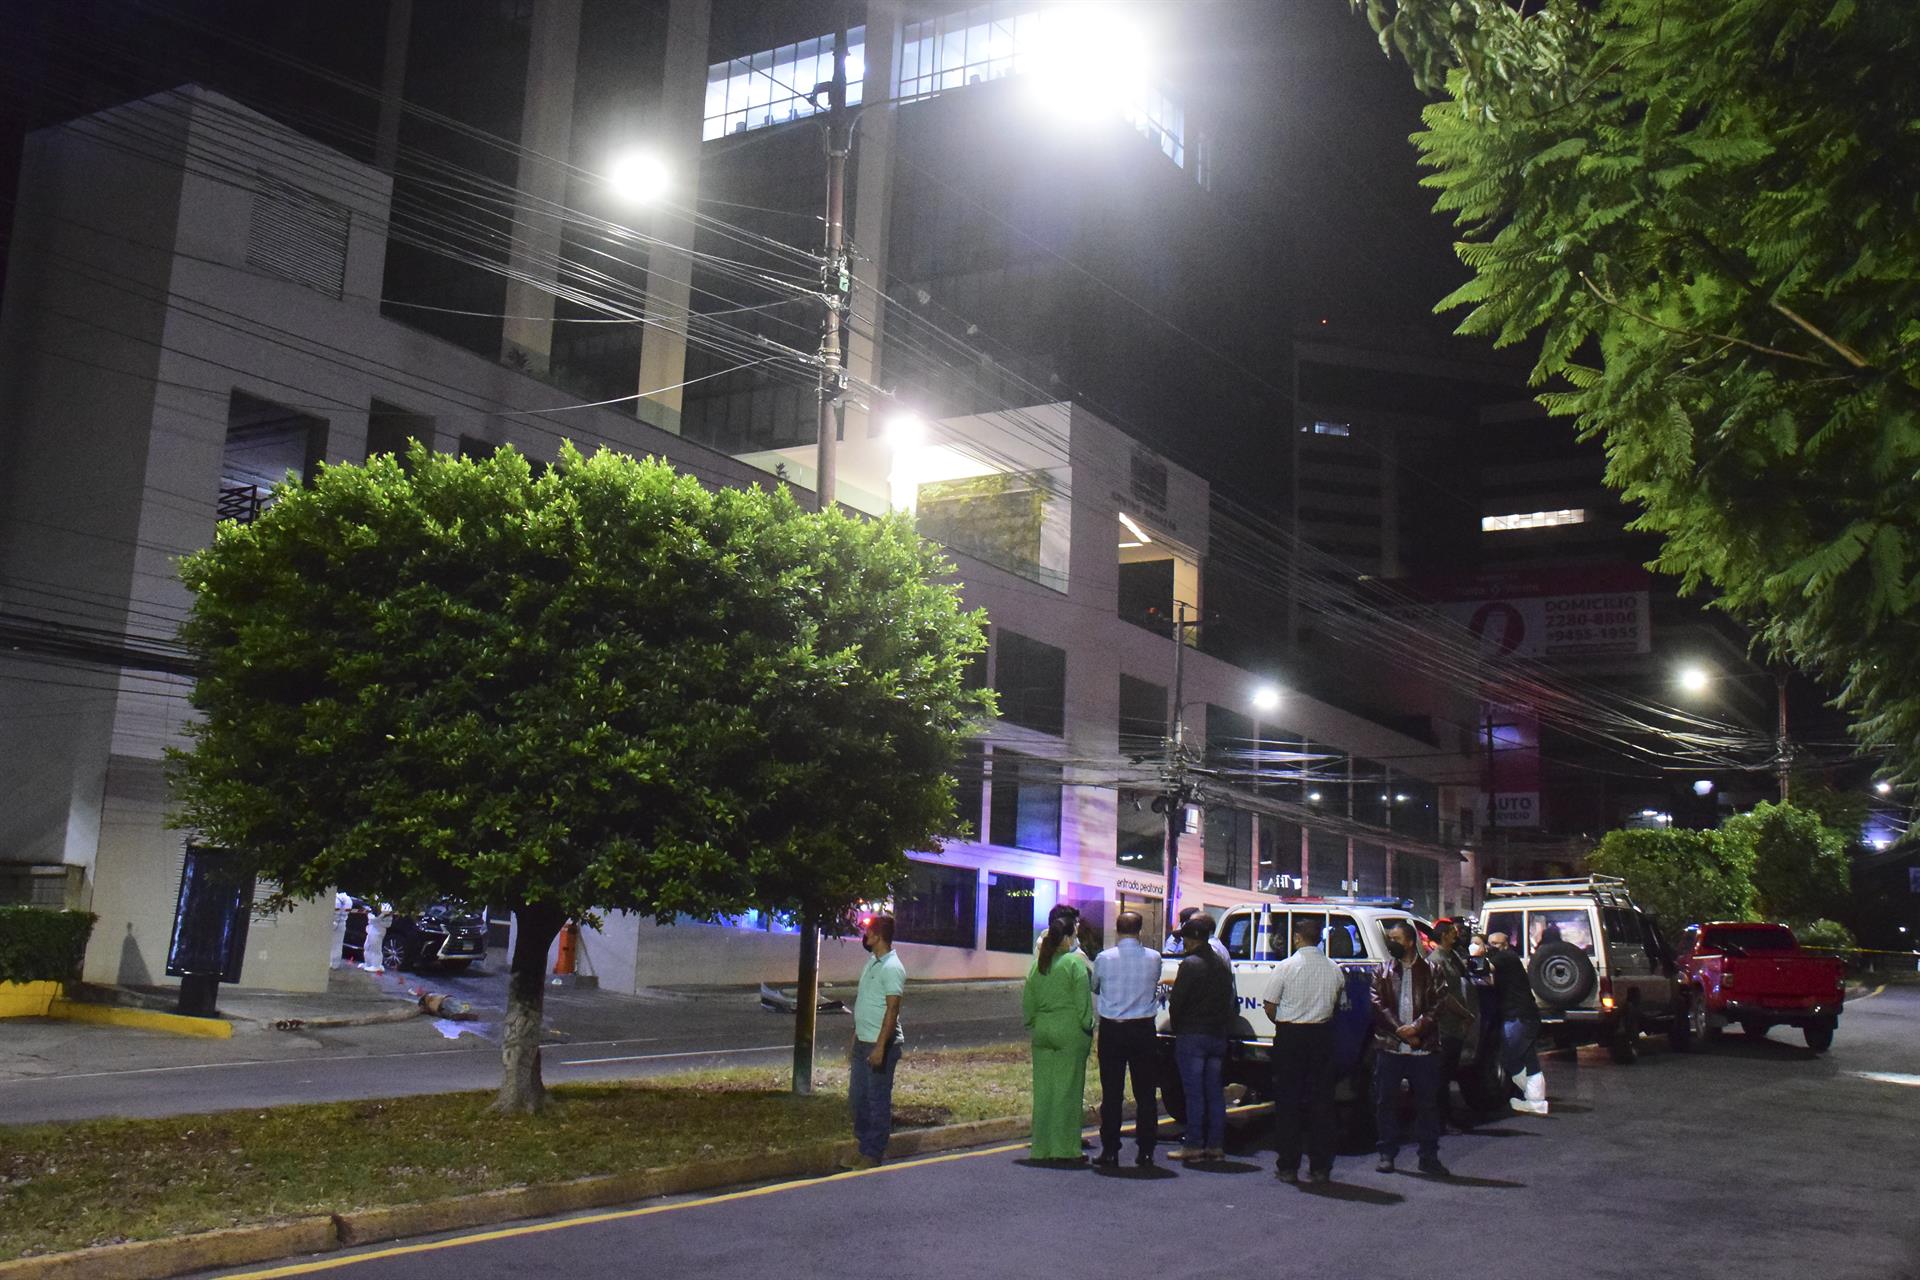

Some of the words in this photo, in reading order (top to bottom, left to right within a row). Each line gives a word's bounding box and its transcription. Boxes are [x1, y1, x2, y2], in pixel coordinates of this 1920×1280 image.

[1545, 596, 1637, 612] DOMICILIO
[1116, 877, 1139, 891] entrada
[1139, 883, 1164, 895] peatonal
[1235, 996, 1264, 1009] PN-
